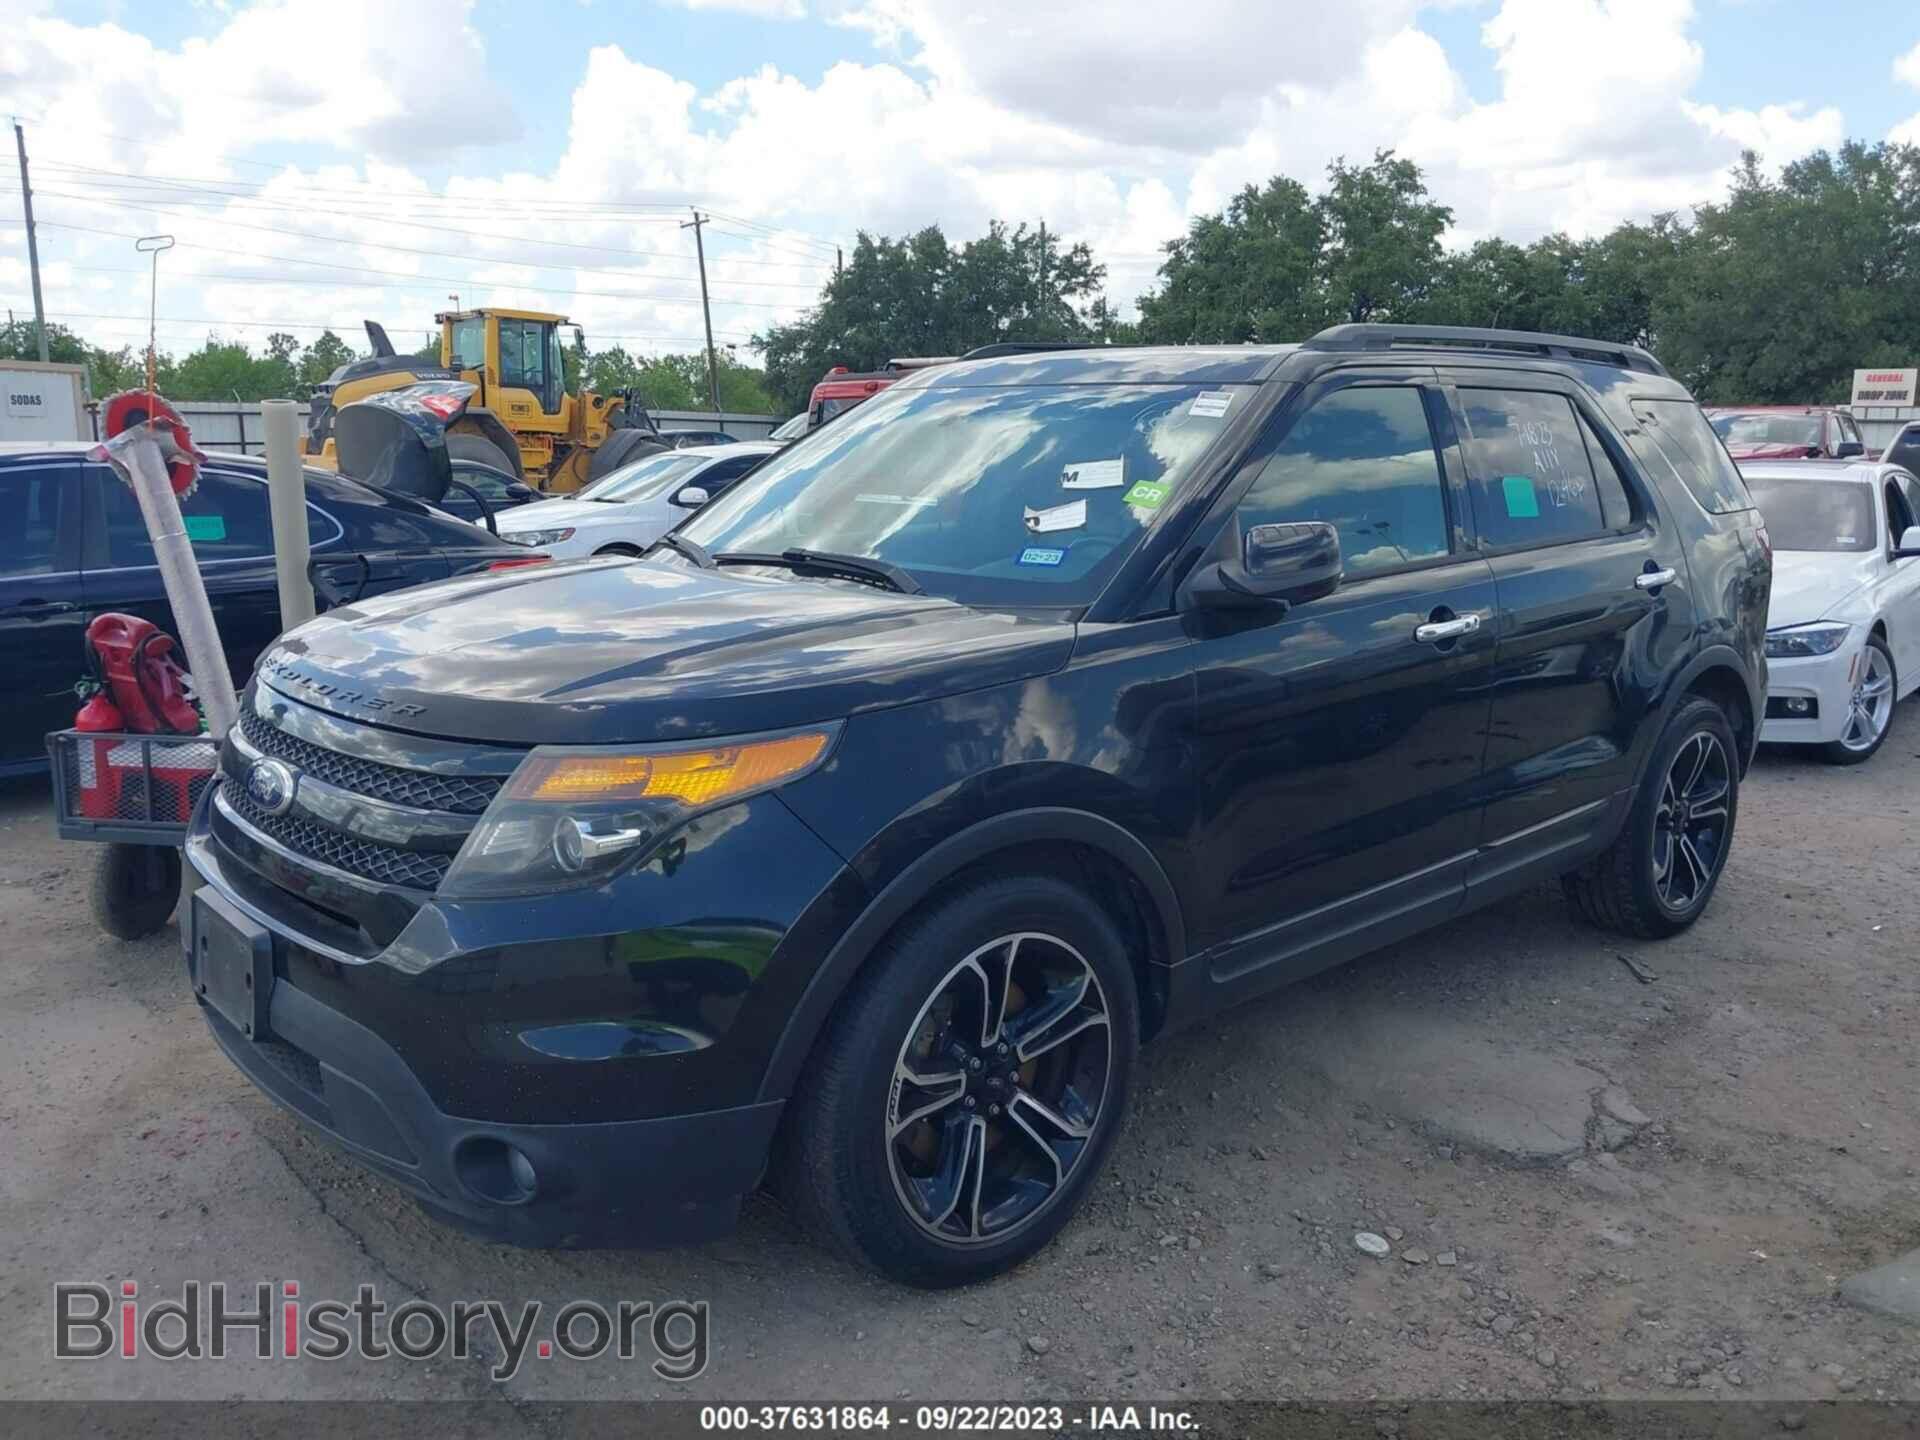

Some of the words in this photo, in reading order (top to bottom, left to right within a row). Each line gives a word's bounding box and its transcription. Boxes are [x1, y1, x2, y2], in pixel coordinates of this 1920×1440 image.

[10, 394, 42, 406] SODAS
[1132, 486, 1162, 501] CR
[265, 658, 427, 718] EXPLORER
